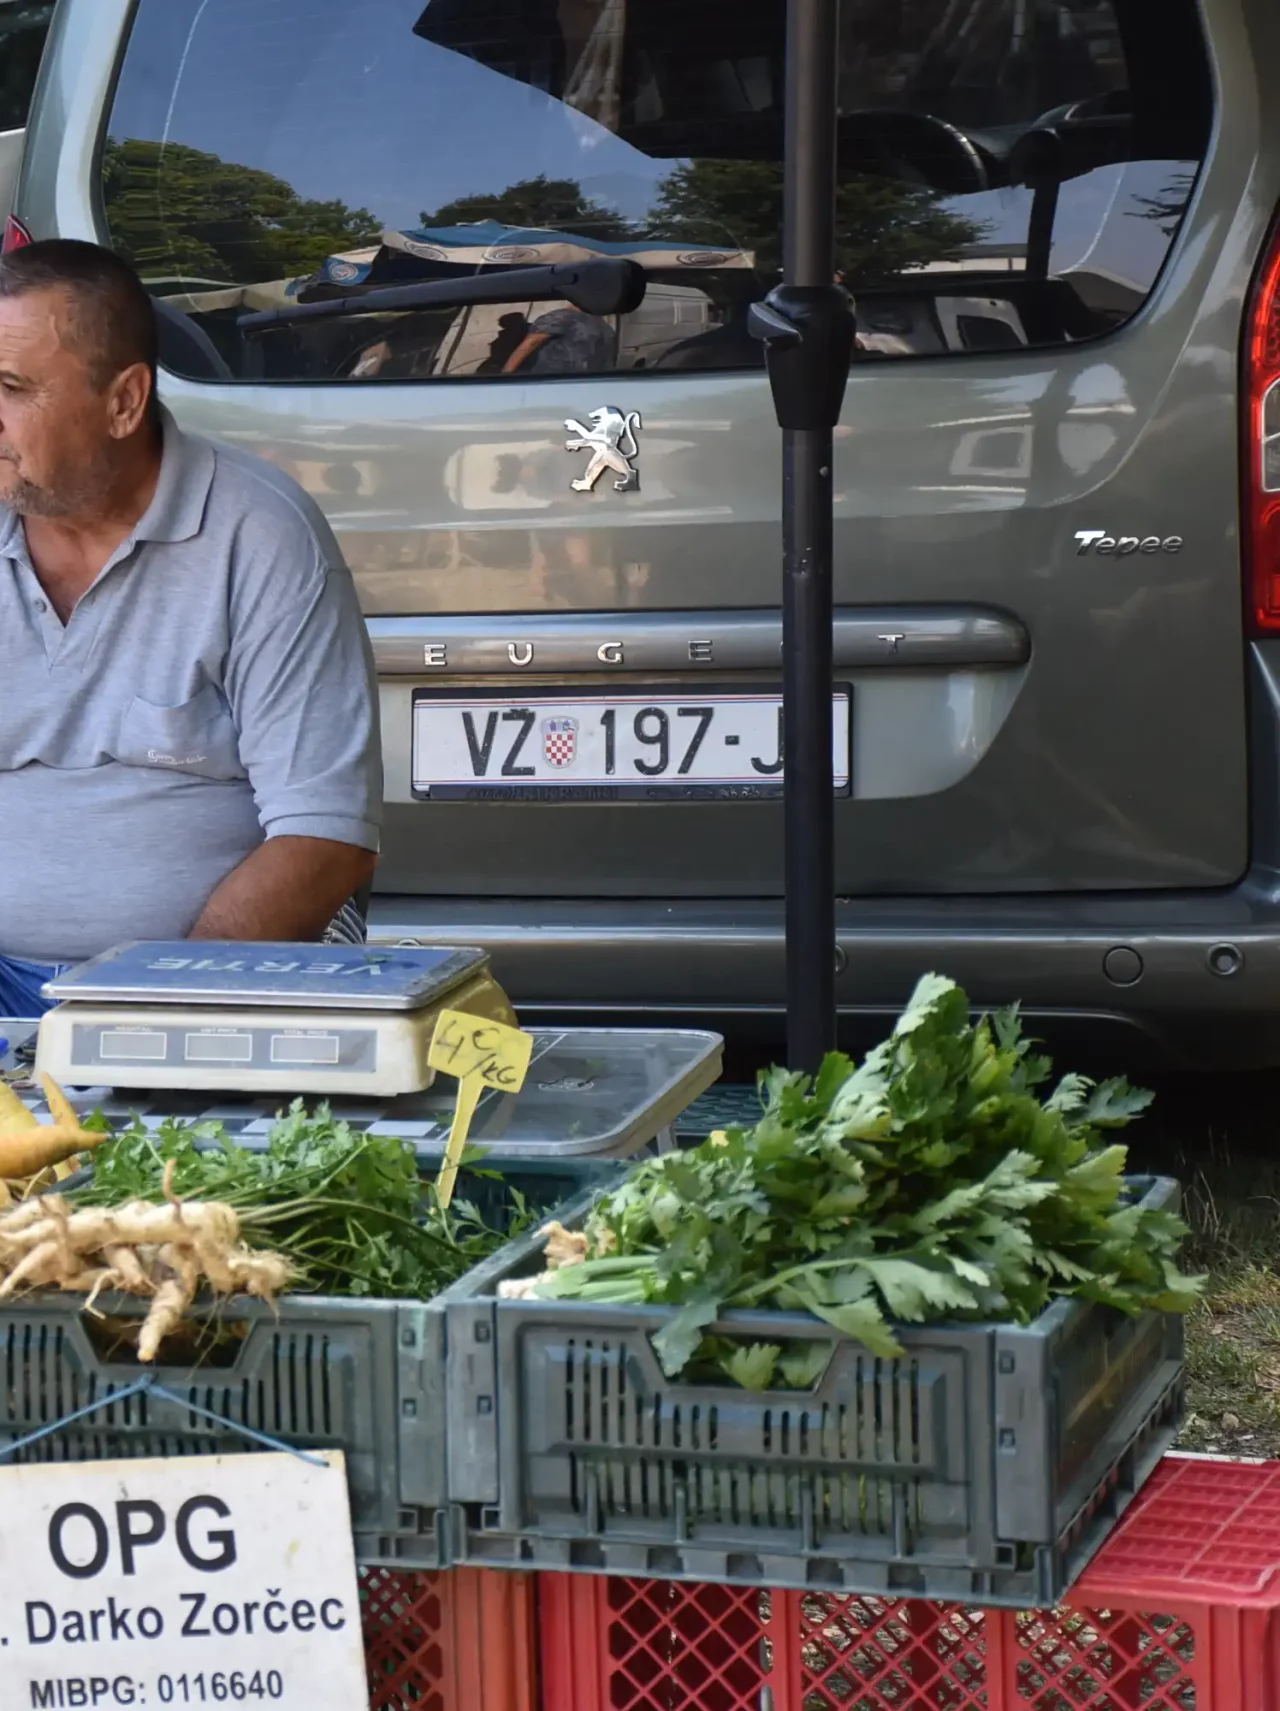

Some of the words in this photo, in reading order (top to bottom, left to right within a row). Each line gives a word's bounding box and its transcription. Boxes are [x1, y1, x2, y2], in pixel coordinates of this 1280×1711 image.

[1073, 529, 1183, 561] Tepee
[423, 633, 906, 668] EUGET
[48, 1494, 238, 1580] OPG
[24, 1596, 165, 1645] Darko
[178, 1588, 346, 1637] Zorčec
[29, 1674, 147, 1709] MIBPG:
[157, 1669, 284, 1702] 0116640
